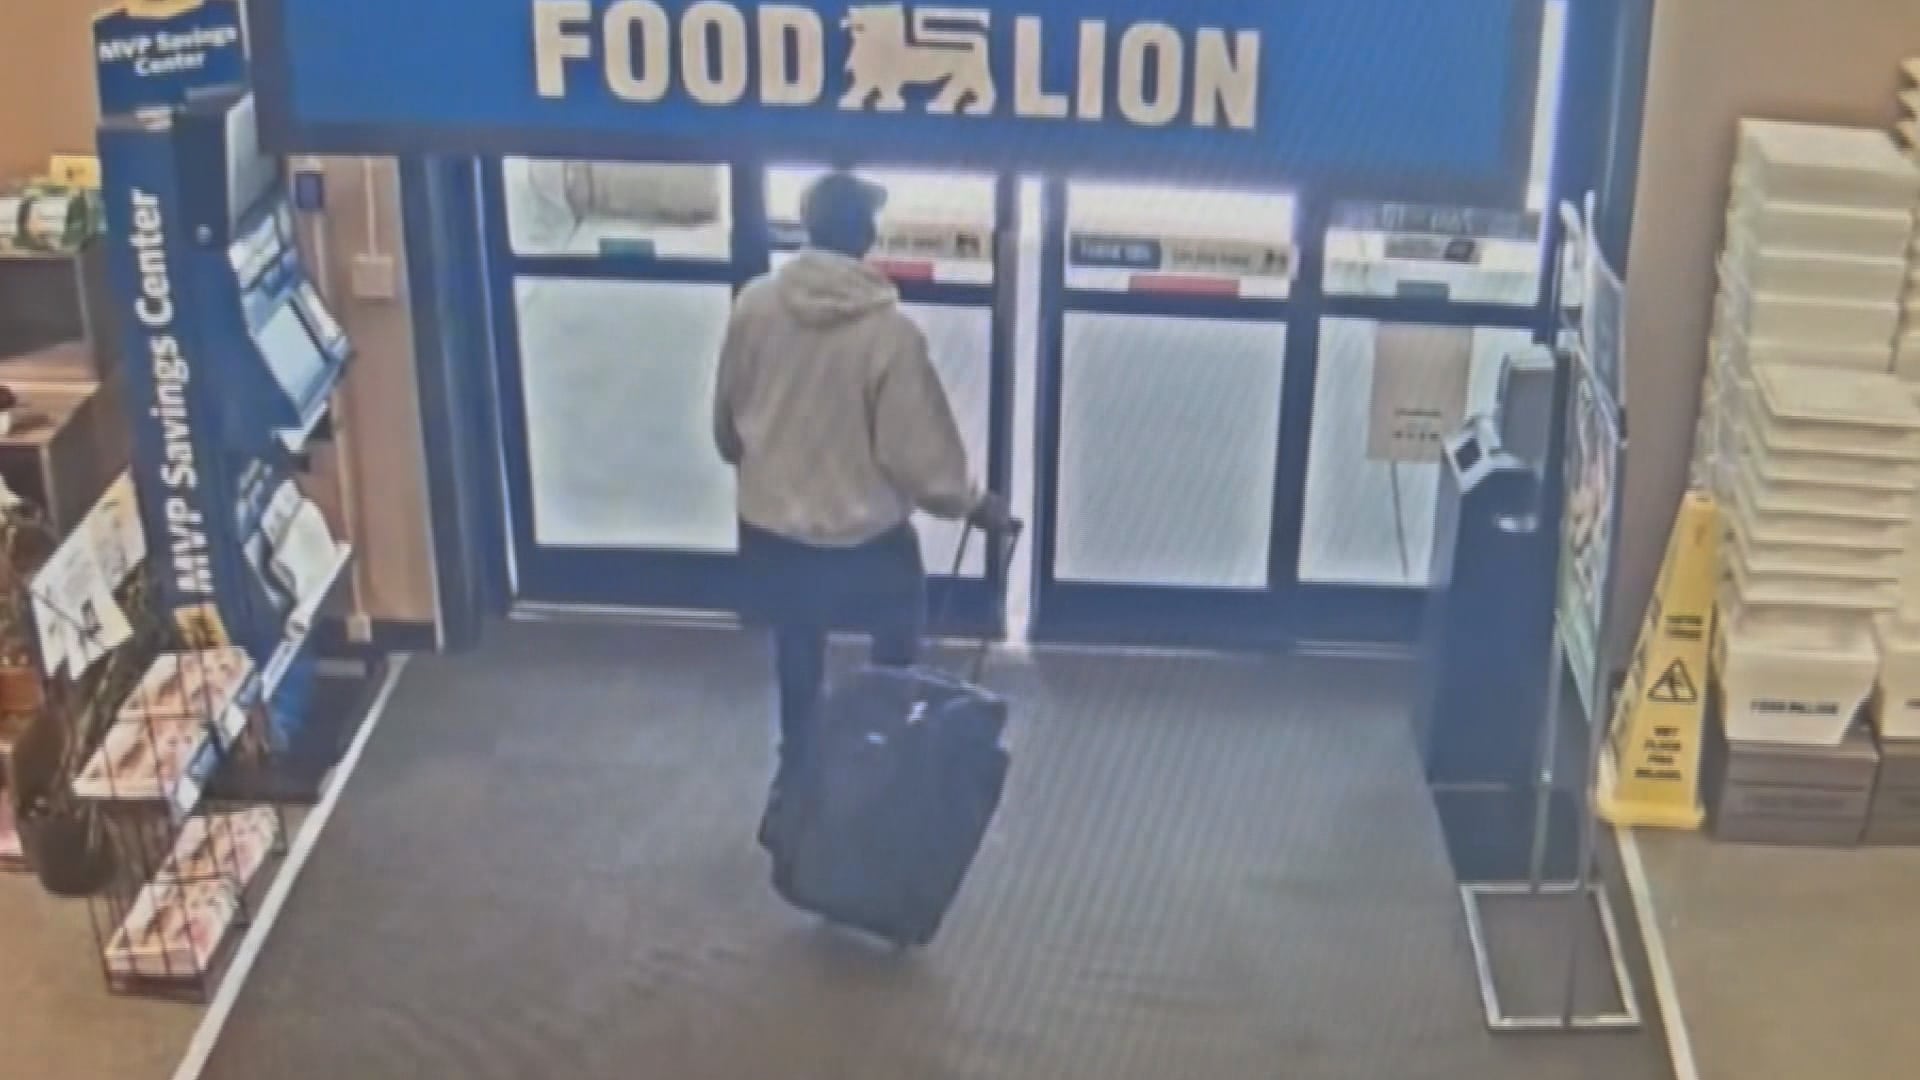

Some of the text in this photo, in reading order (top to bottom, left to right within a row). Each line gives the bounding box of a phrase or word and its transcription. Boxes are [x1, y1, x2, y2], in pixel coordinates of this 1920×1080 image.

[99, 27, 237, 62] MVP Savings
[134, 53, 206, 76] Center
[532, 0, 1260, 129] FOOD LION
[129, 187, 174, 325] Center
[149, 335, 197, 489] Savings
[165, 497, 213, 592] MVP
